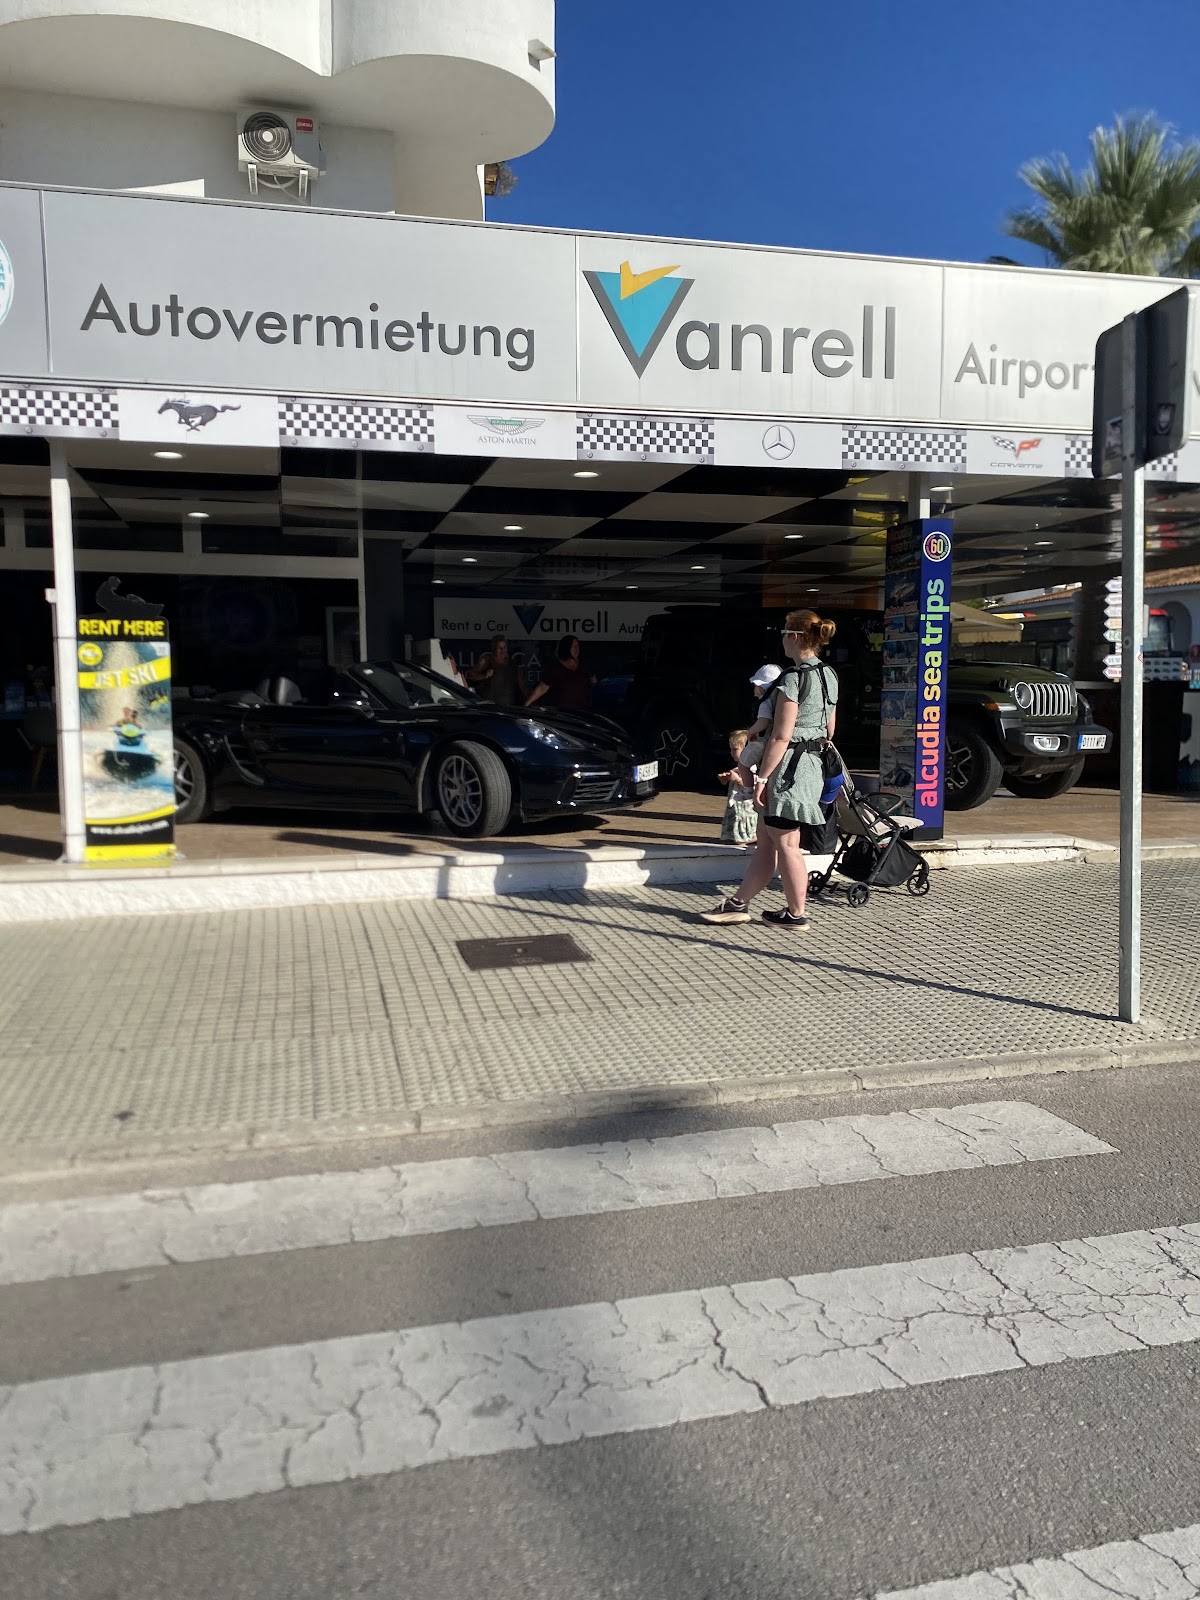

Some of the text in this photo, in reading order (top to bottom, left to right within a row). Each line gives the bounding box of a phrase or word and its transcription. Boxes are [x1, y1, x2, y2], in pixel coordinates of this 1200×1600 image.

[80, 282, 535, 372] Autovermietung
[582, 263, 896, 380] Vanrell
[954, 341, 1096, 398] Airpor
[478, 435, 536, 445] ASTON MARTIN
[930, 538, 944, 554] 60
[79, 619, 165, 637] RENT HERE
[441, 618, 469, 631] Rent
[474, 623, 482, 632] a
[486, 619, 510, 632] Car
[512, 604, 608, 635] Vanrell
[920, 578, 950, 647] trips
[94, 663, 158, 688] JET SKI
[923, 651, 942, 702] sea
[916, 706, 941, 808] alcudia
